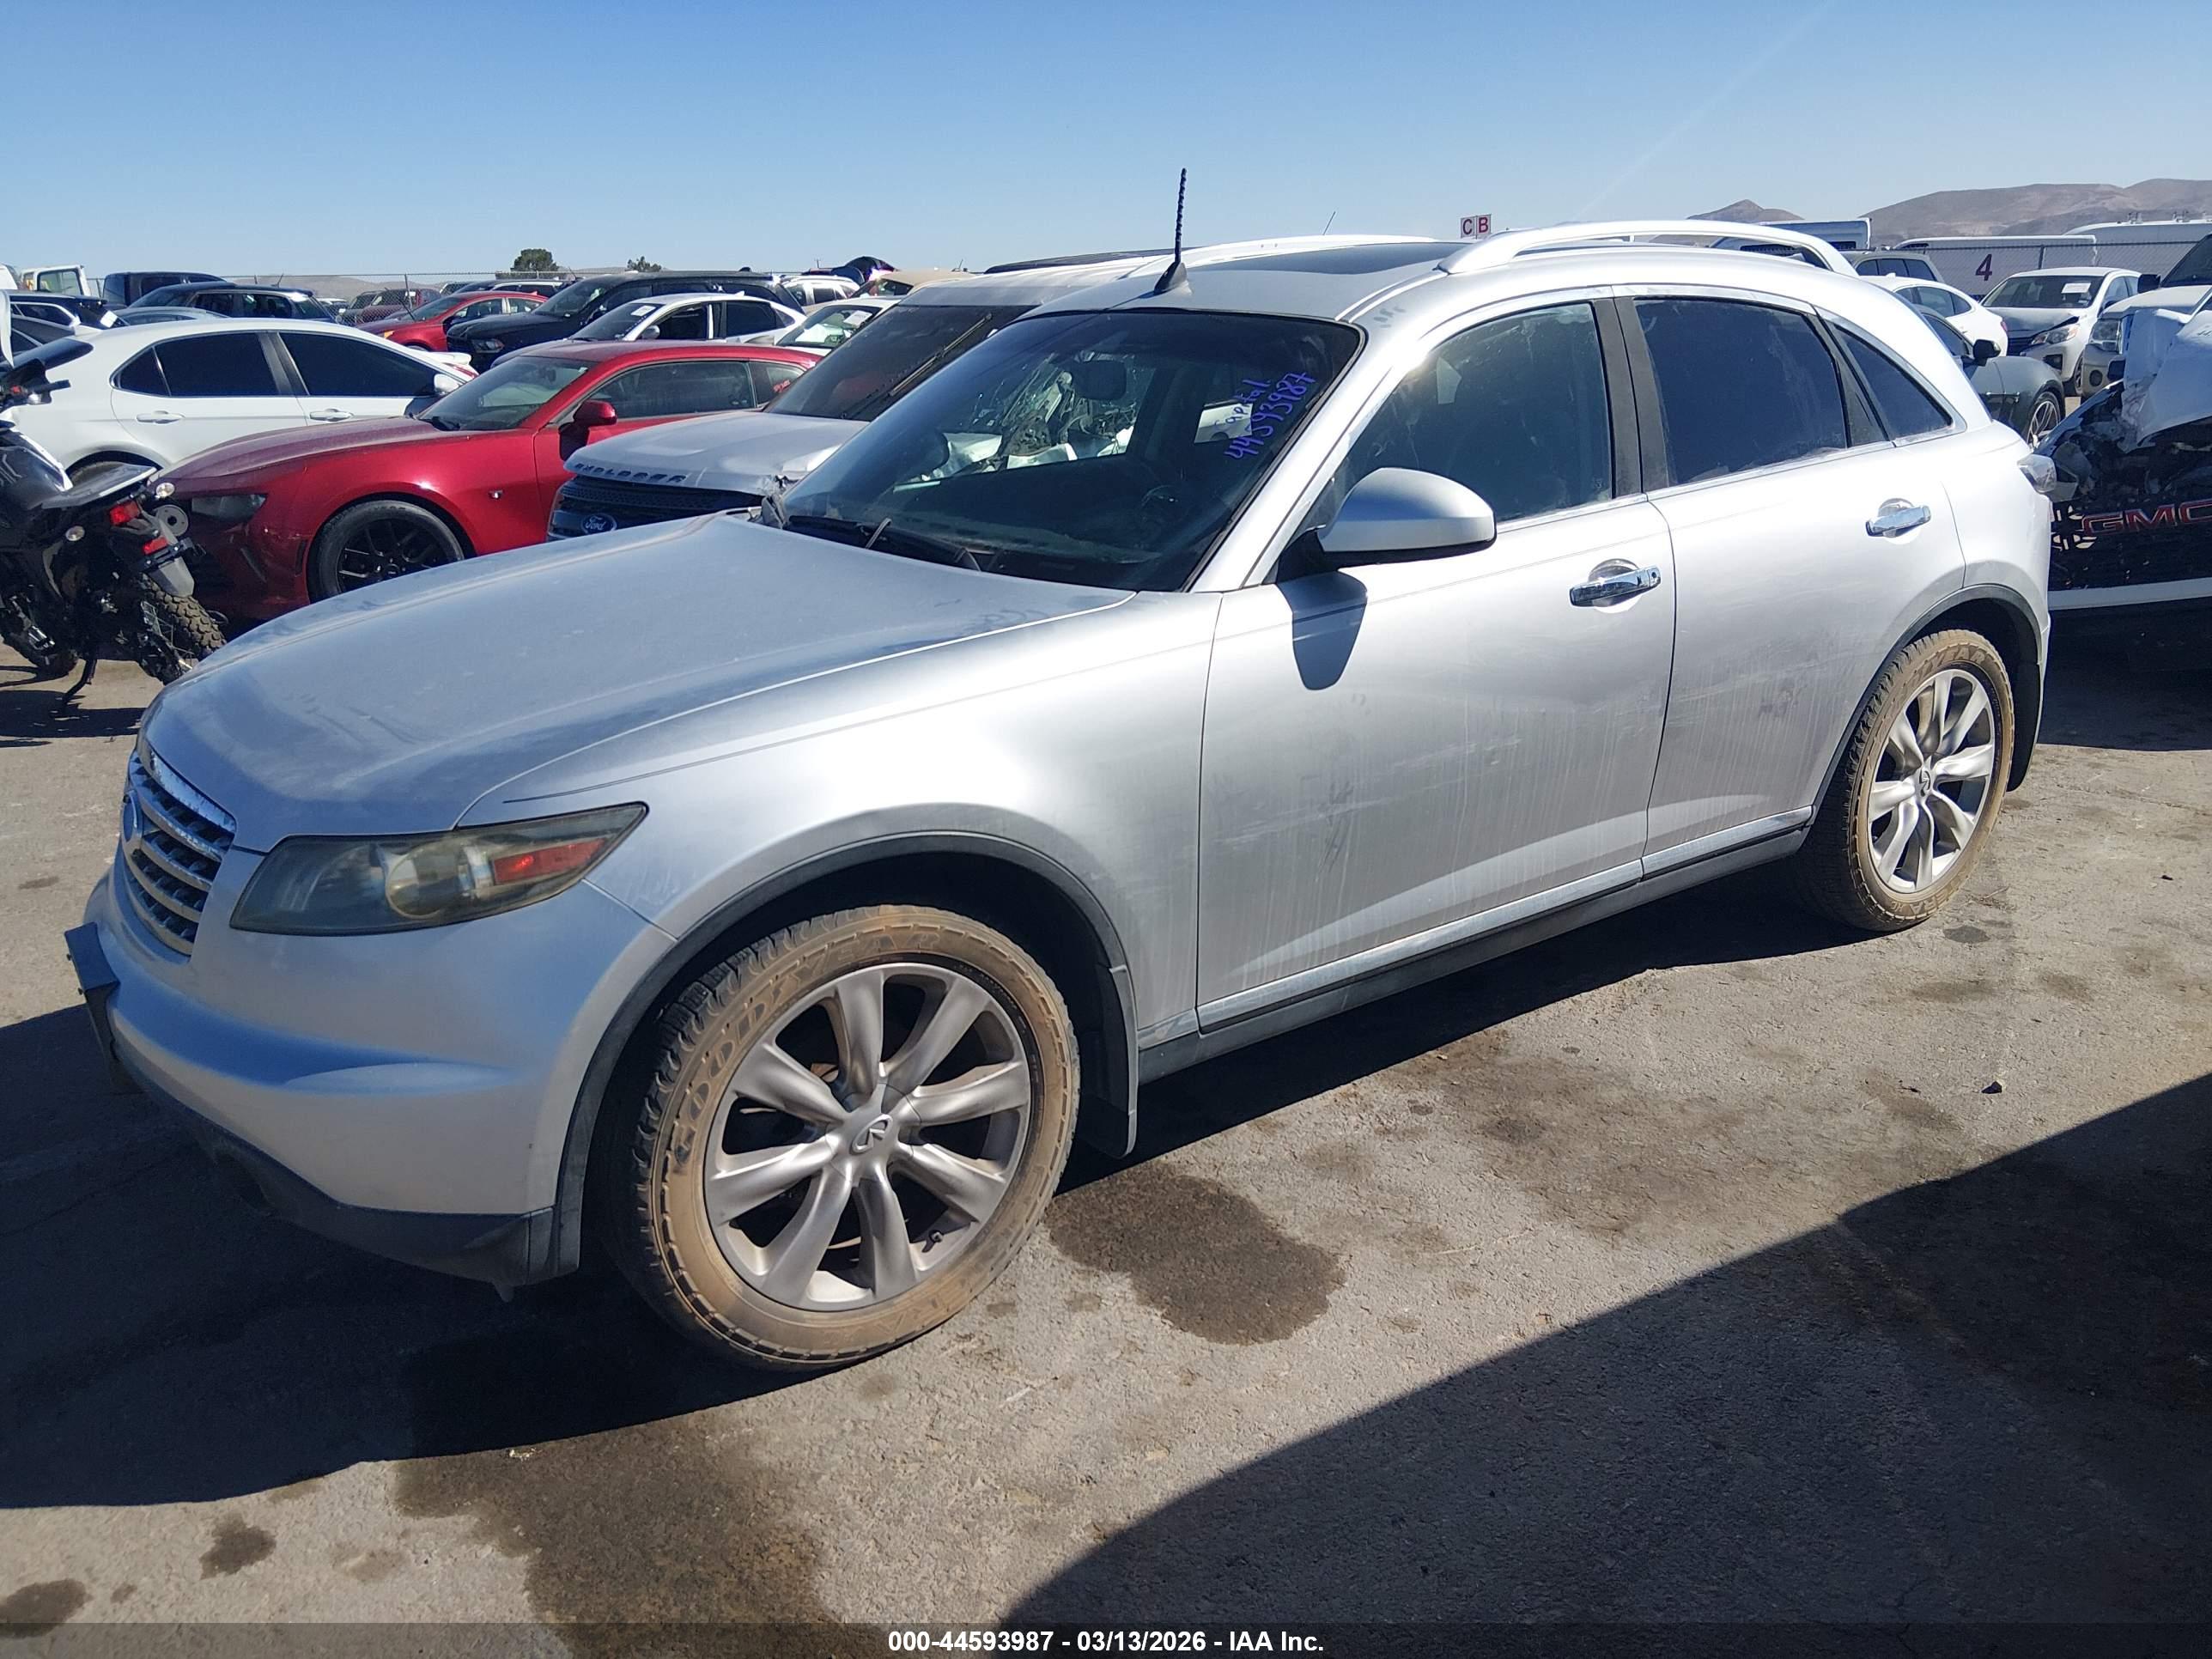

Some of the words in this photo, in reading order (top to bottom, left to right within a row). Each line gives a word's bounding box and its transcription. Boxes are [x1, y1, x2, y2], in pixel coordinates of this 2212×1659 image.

[1462, 218, 1473, 235] C
[1478, 216, 1489, 234] B
[1975, 253, 1992, 282] 4
[1224, 372, 1316, 459] 44593987
[574, 463, 687, 483] EXPLORER
[585, 515, 606, 532] Ford
[2081, 498, 2212, 537] GMC
